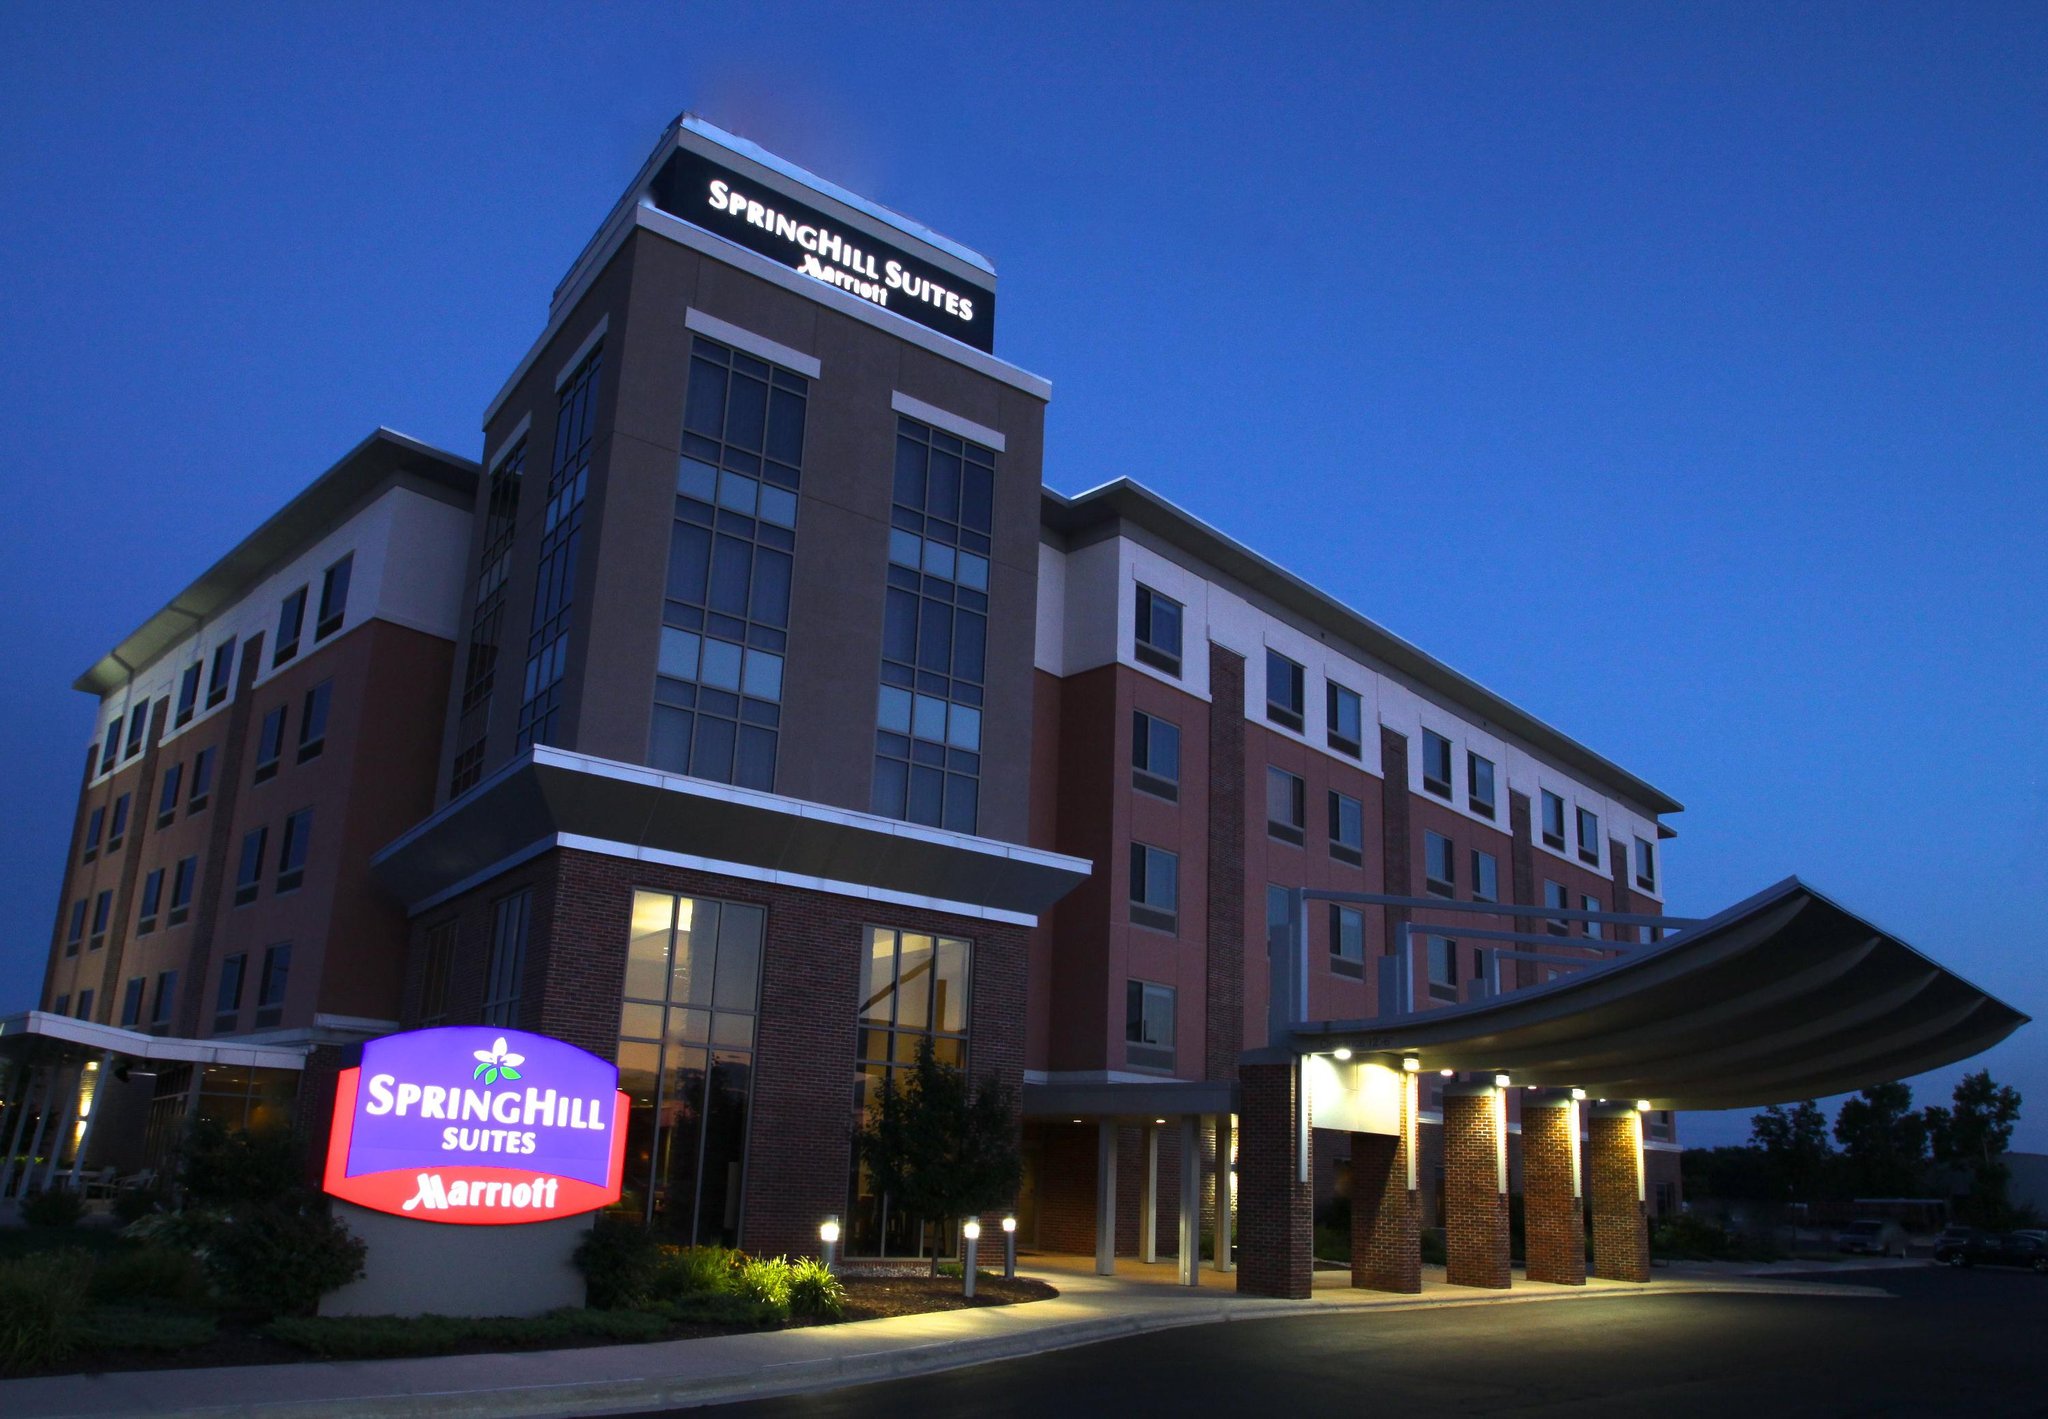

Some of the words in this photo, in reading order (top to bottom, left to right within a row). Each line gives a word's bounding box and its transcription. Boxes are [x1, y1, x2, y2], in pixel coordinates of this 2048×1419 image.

[708, 180, 879, 280] SPRINGHILL
[885, 260, 974, 322] SUITES
[797, 253, 889, 306] Marriott
[366, 1073, 605, 1131] SPRINGHILL
[441, 1126, 536, 1155] SUITES
[402, 1172, 559, 1211] Marriott
